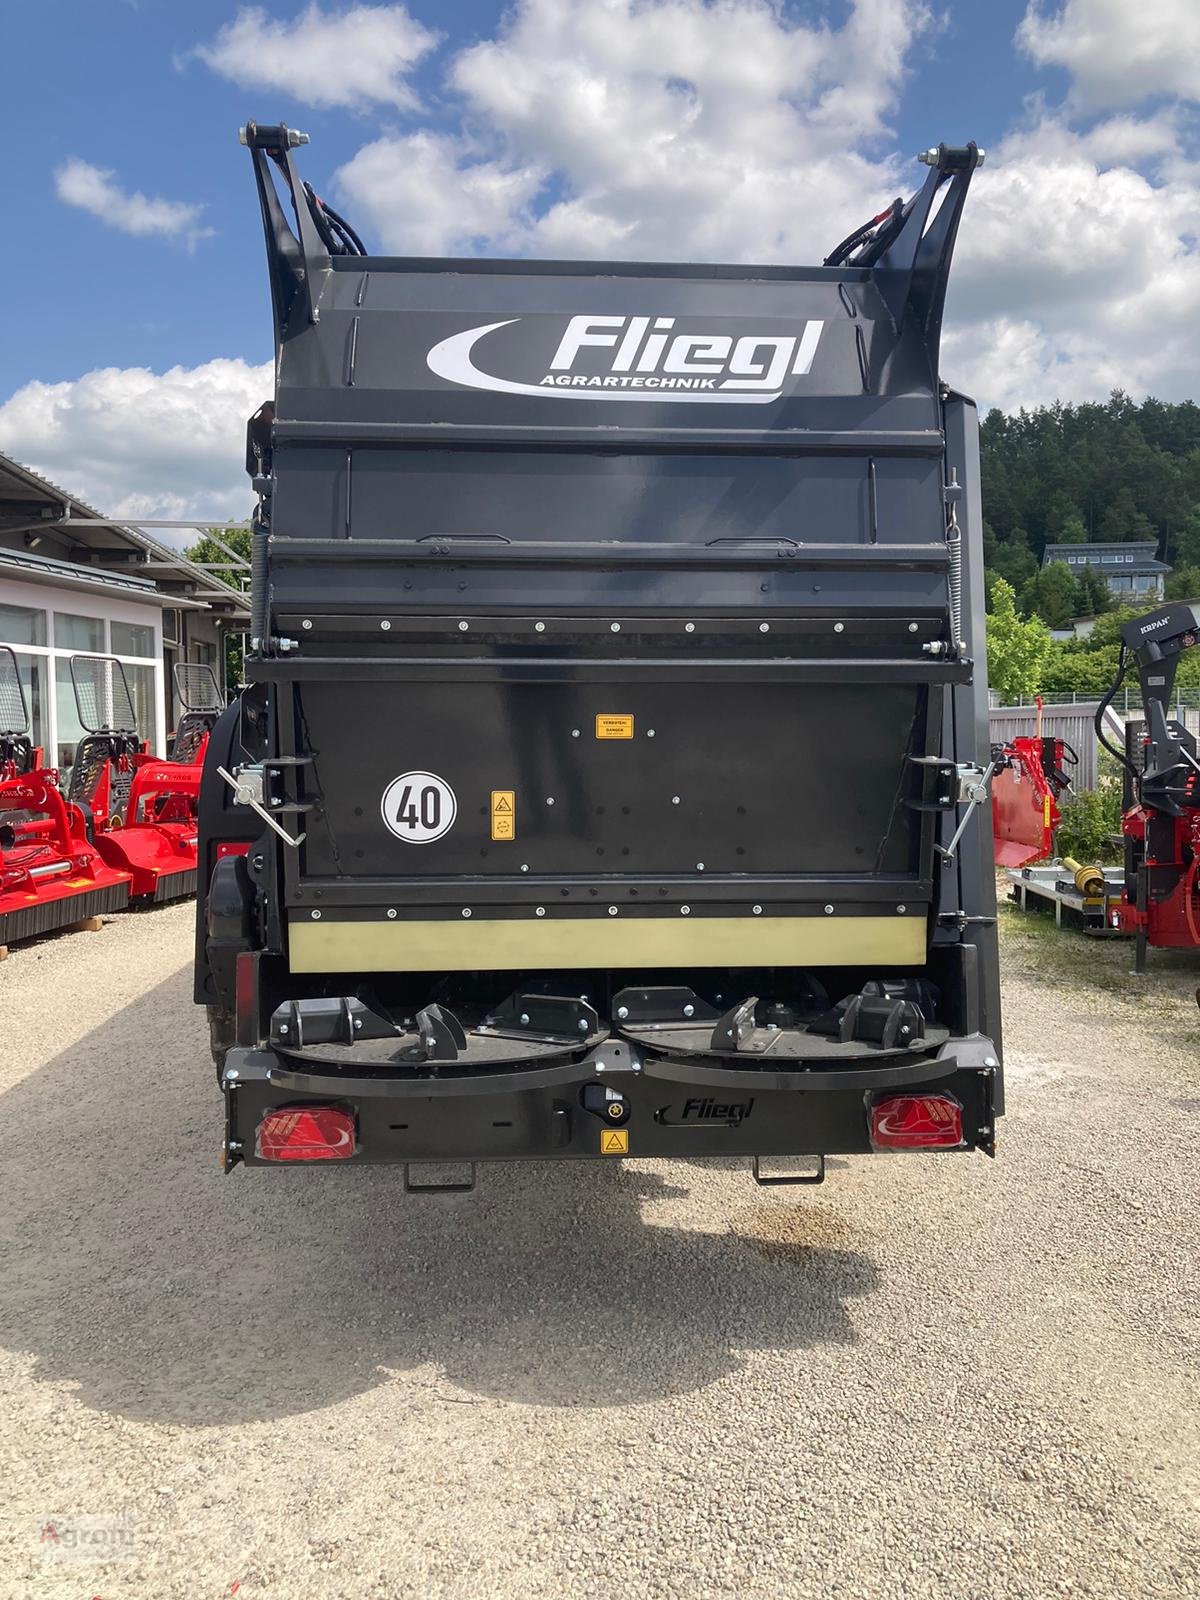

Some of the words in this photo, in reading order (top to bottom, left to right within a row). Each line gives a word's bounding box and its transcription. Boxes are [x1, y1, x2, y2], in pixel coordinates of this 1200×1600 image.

[549, 315, 825, 390] Fliegl
[540, 374, 718, 390] AGRARTECHNIK
[395, 785, 441, 829] 40
[681, 1097, 755, 1123] Fliegl
